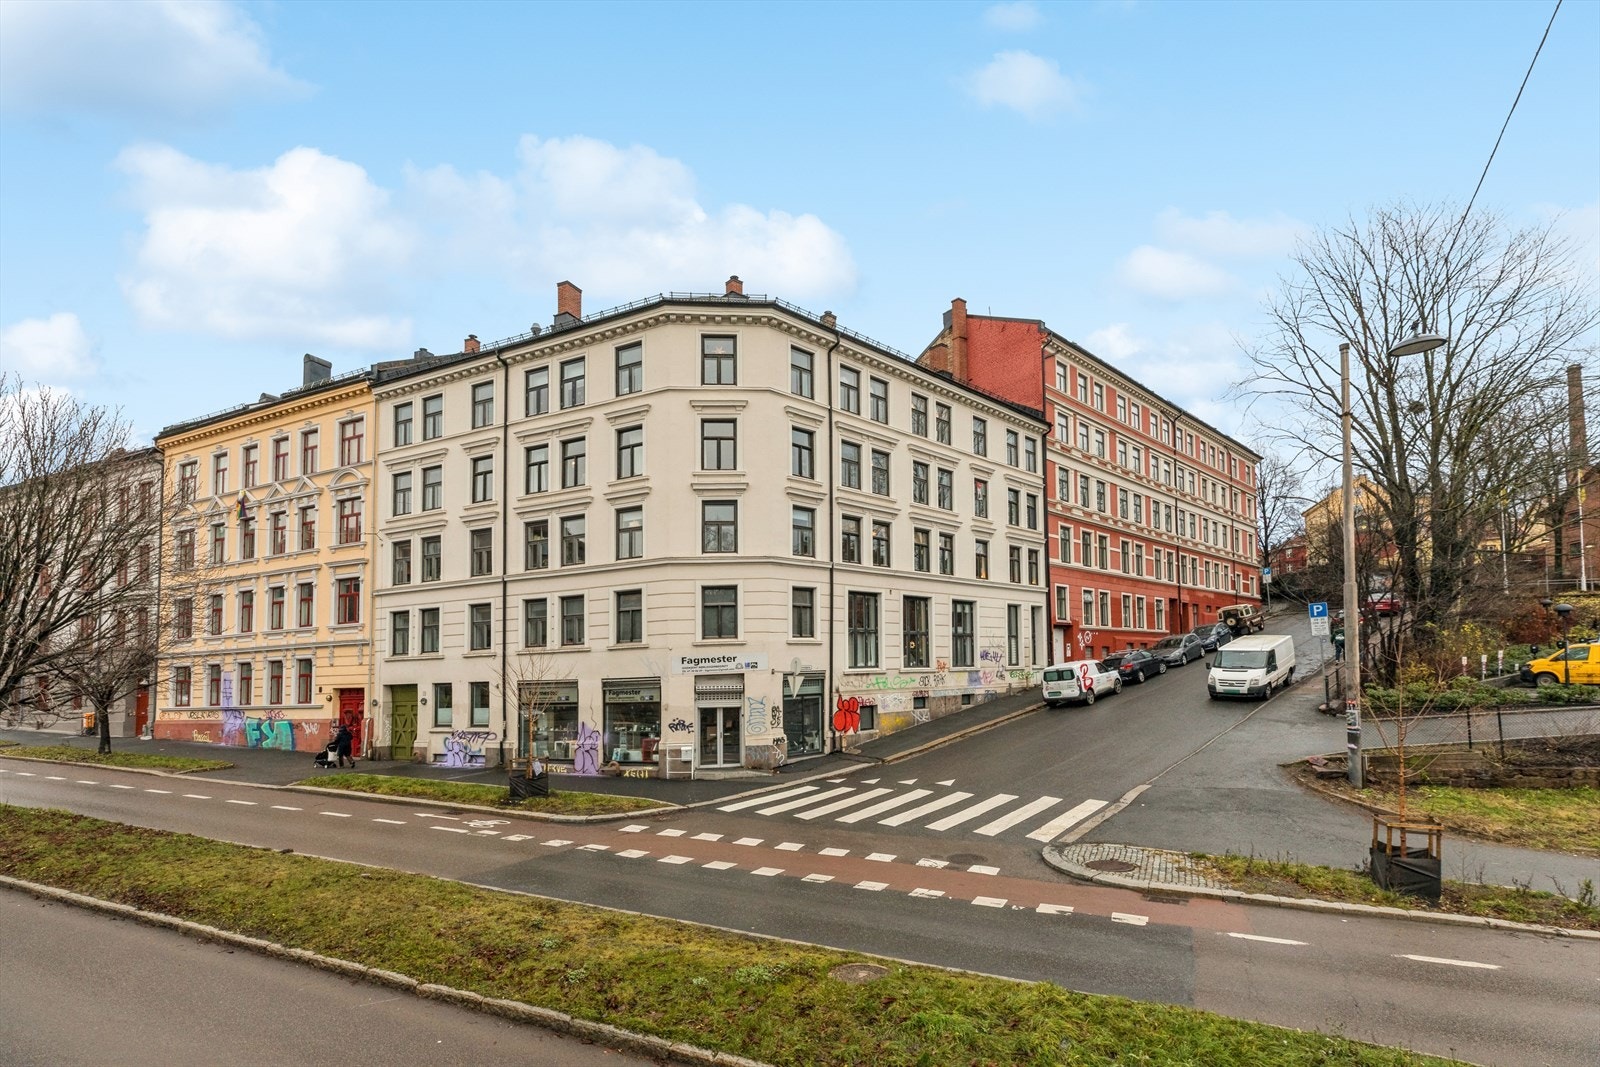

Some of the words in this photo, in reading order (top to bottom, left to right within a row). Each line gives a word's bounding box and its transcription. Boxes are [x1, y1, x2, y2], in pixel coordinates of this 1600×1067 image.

[1313, 605, 1323, 616] P
[681, 655, 737, 666] Fagmester
[608, 689, 641, 697] Fagmester
